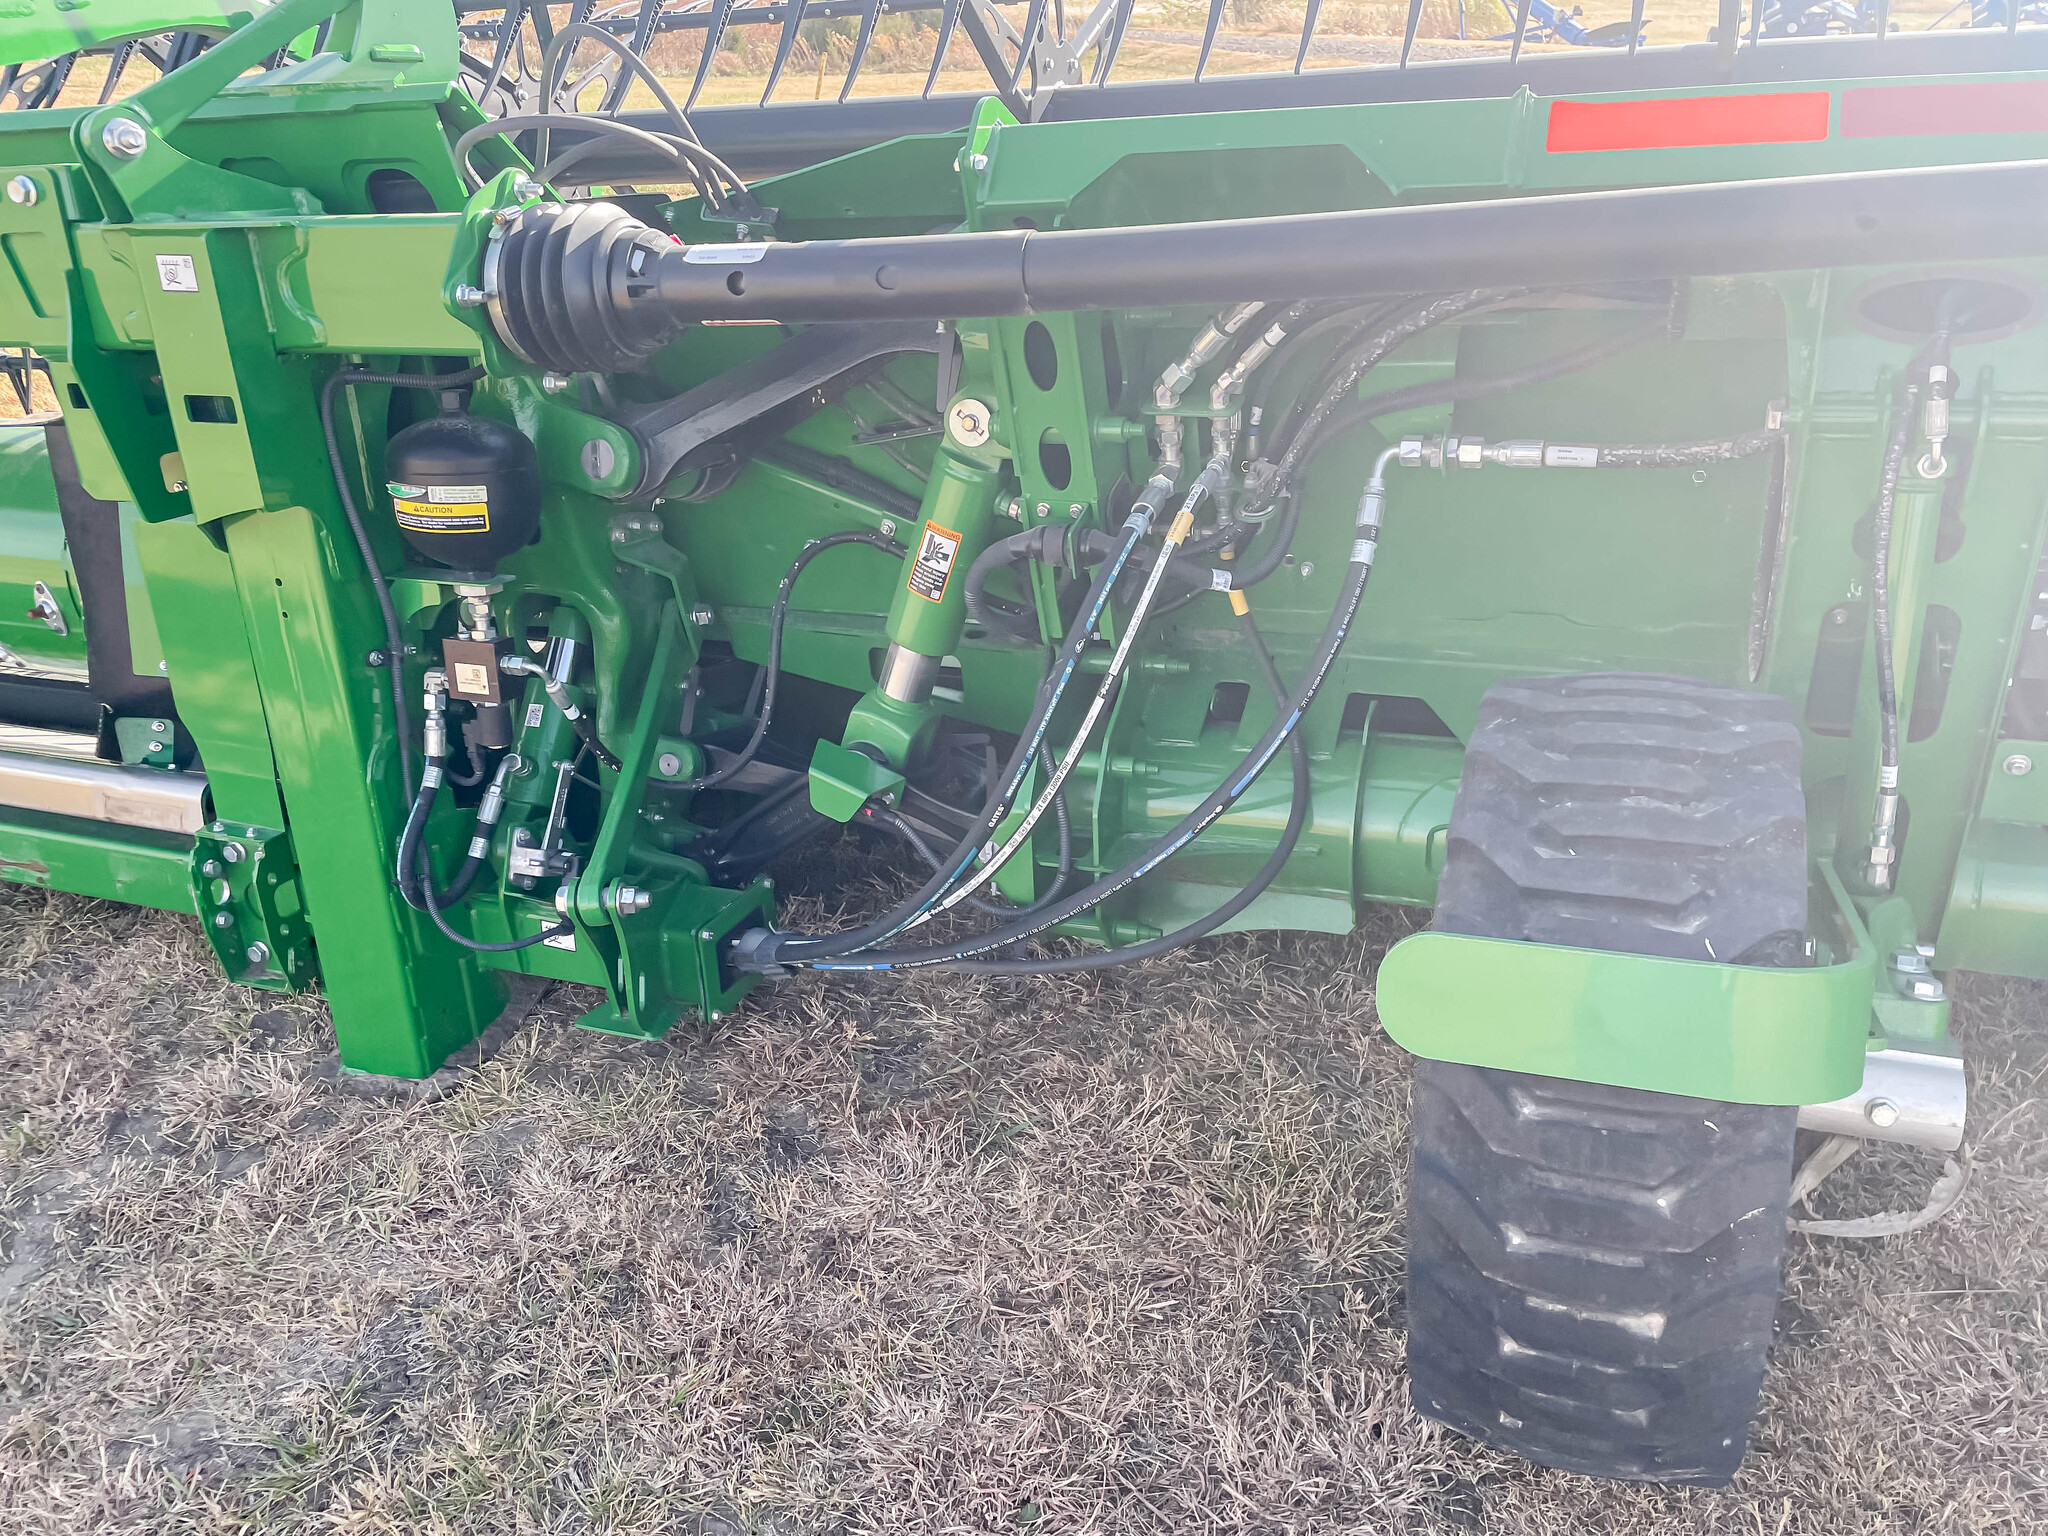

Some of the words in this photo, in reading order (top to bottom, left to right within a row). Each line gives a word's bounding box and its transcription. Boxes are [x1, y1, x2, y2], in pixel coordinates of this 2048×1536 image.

[931, 525, 961, 540] WARNING
[1342, 613, 1351, 624] Type
[1329, 638, 1341, 654] Flame
[1318, 653, 1333, 675] Resistant
[1100, 673, 1114, 694] Parker
[1038, 719, 1047, 731] XTP
[1055, 681, 1065, 694] Plus
[1035, 803, 1043, 812] 21
[1040, 790, 1052, 804] MPa
[1048, 774, 1062, 791] (3000
[1058, 760, 1070, 775] PSI)
[987, 804, 1004, 828] GATES
[1112, 883, 1122, 891] MPa
